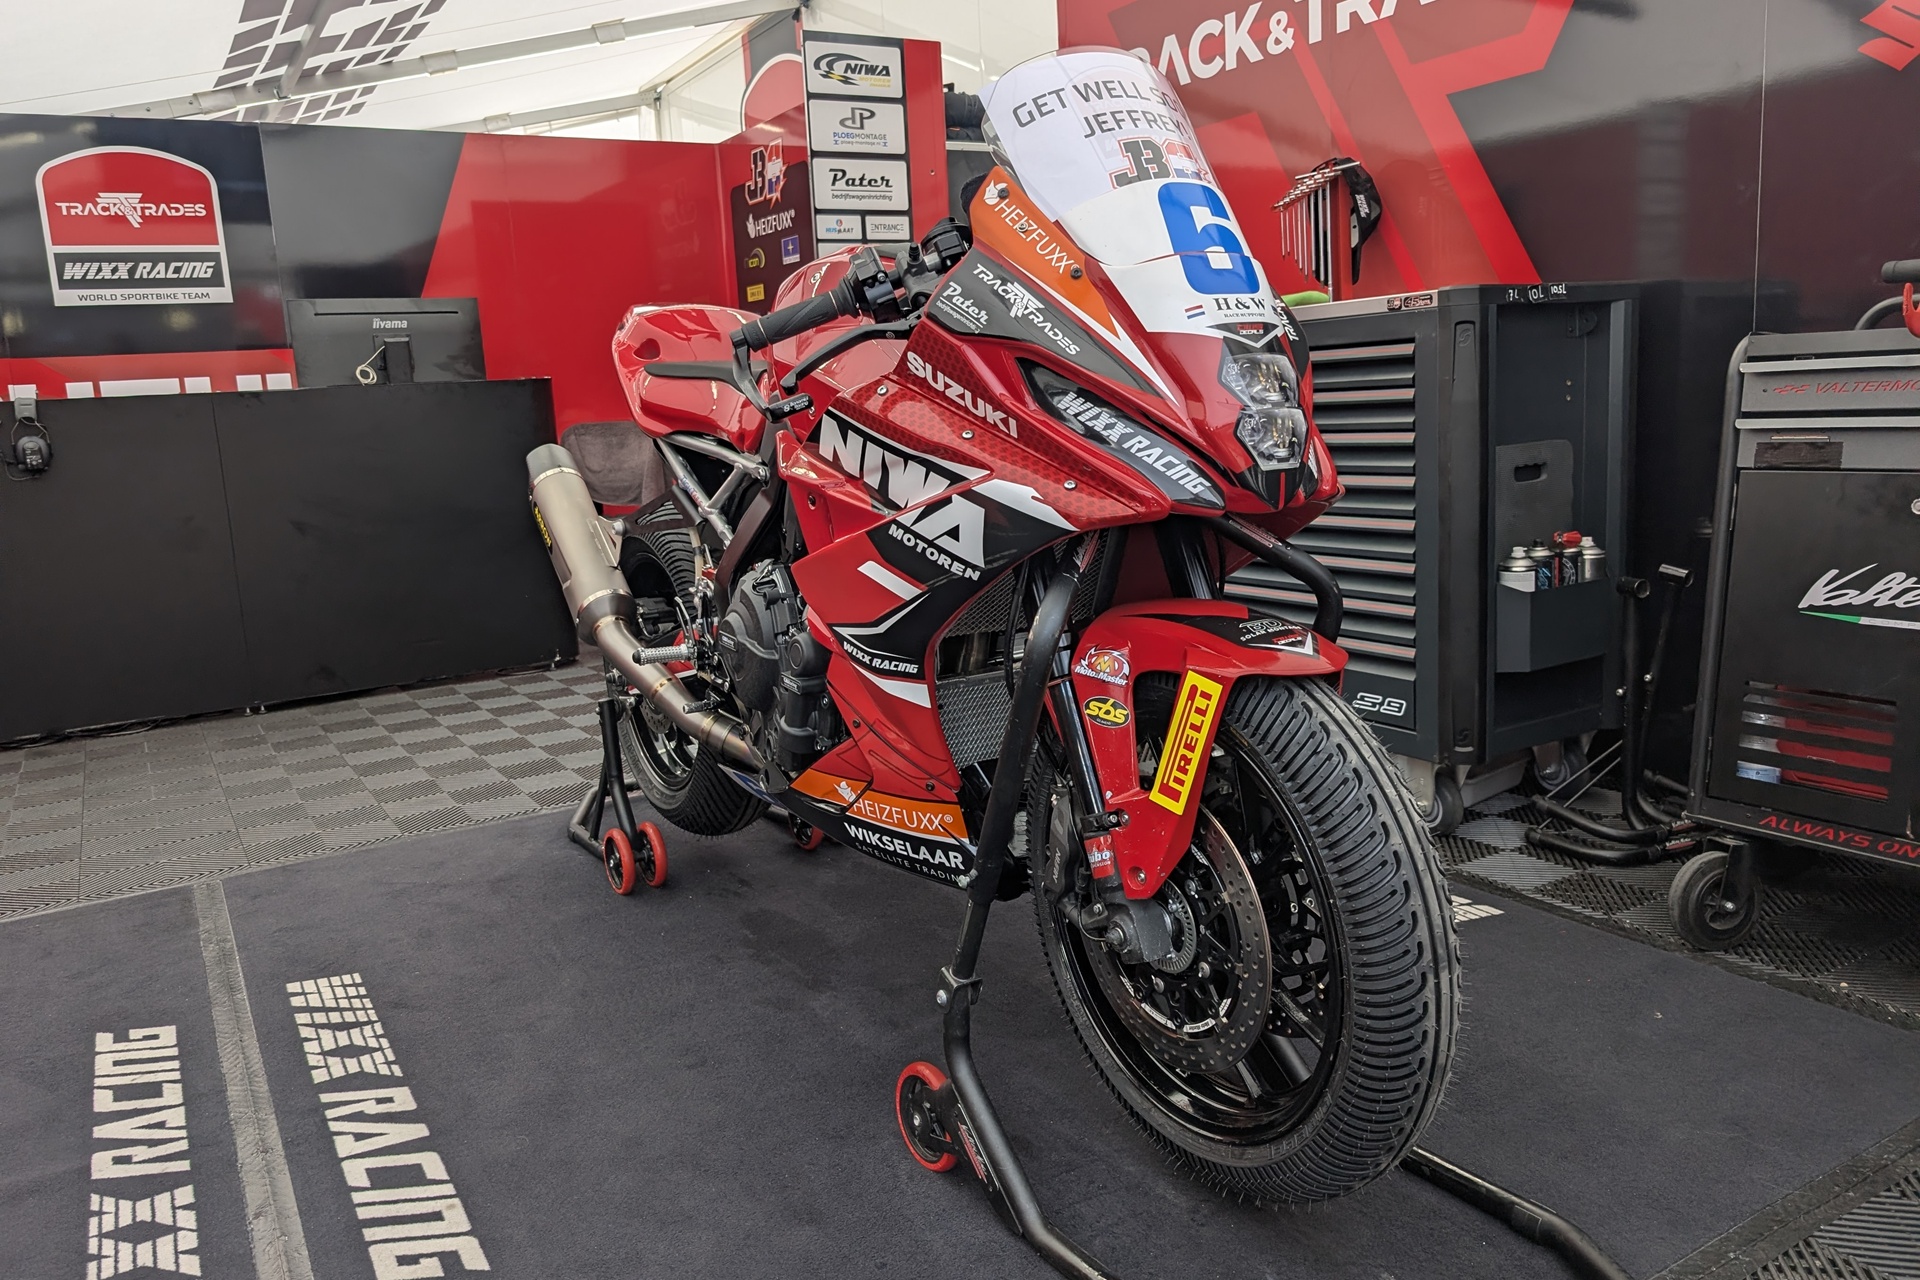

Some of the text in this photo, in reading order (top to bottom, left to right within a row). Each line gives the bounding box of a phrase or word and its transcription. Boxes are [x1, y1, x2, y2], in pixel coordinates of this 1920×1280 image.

[843, 62, 891, 77] NIWA
[1012, 87, 1068, 128] GET
[1072, 80, 1152, 103] WELL
[833, 132, 887, 141] PLOEGMONTAGE
[1083, 110, 1192, 139] JEFFREY!
[828, 168, 893, 188] Pater
[870, 223, 904, 232] ENTRANCE
[1157, 181, 1261, 295] 6
[63, 261, 216, 280] WIXX RACING
[78, 292, 211, 302] WORLD SPORTBIKE TEAM
[942, 281, 989, 325] Pater
[1213, 297, 1266, 311] H & W
[372, 317, 408, 329] iiyama
[906, 351, 1018, 439] SUZUKI
[1056, 391, 1212, 495] WIXX RACING
[819, 413, 986, 568] NIWA
[888, 523, 980, 582] MOTOREN
[843, 640, 919, 674] WIXX RACING
[1085, 698, 1128, 724] sbs
[1157, 683, 1213, 804] PIRELLI
[843, 822, 965, 870] WIKSELAAR
[1759, 815, 1878, 848] ALWAYS
[855, 842, 960, 883] SATELLITE TRADIN
[91, 1025, 191, 1179] RACING
[286, 973, 491, 1280] WIXX RACING
